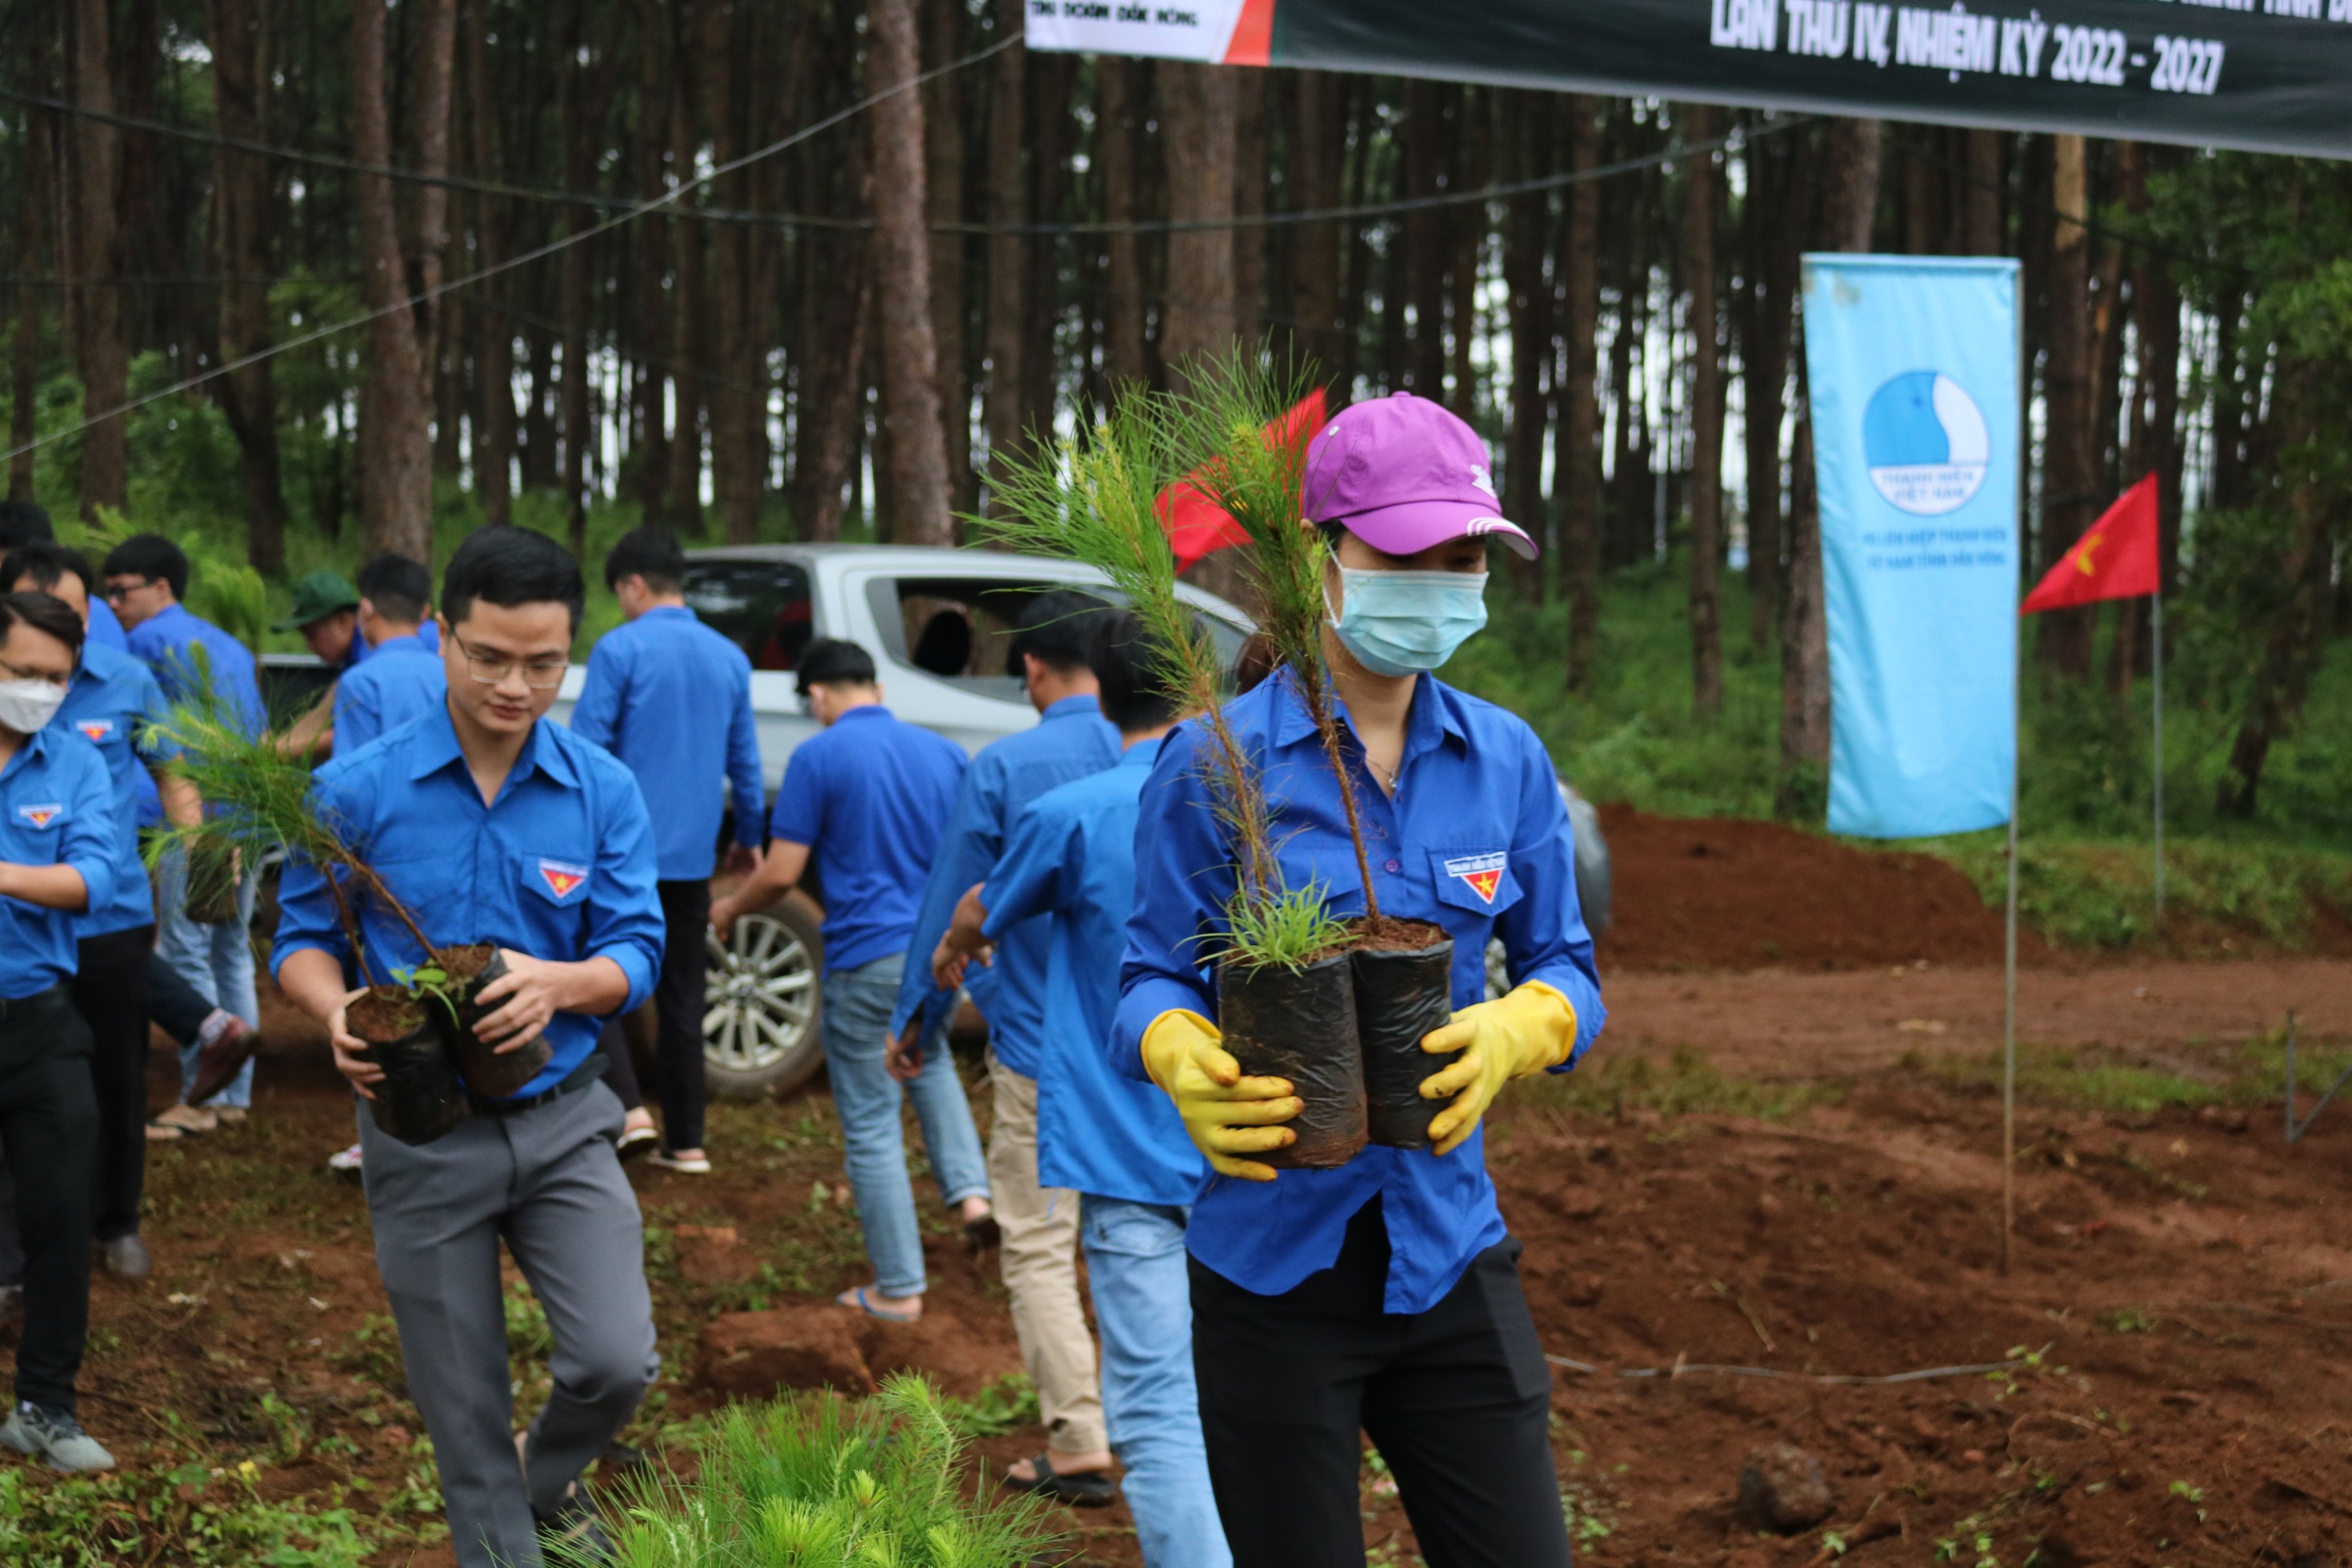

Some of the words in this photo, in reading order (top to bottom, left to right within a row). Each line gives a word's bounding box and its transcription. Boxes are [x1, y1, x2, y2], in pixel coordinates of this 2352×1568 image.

[1895, 1, 1997, 84] NHIỆM
[2051, 22, 2126, 86] 2022
[2130, 53, 2148, 67] -
[2150, 33, 2225, 96] 2027
